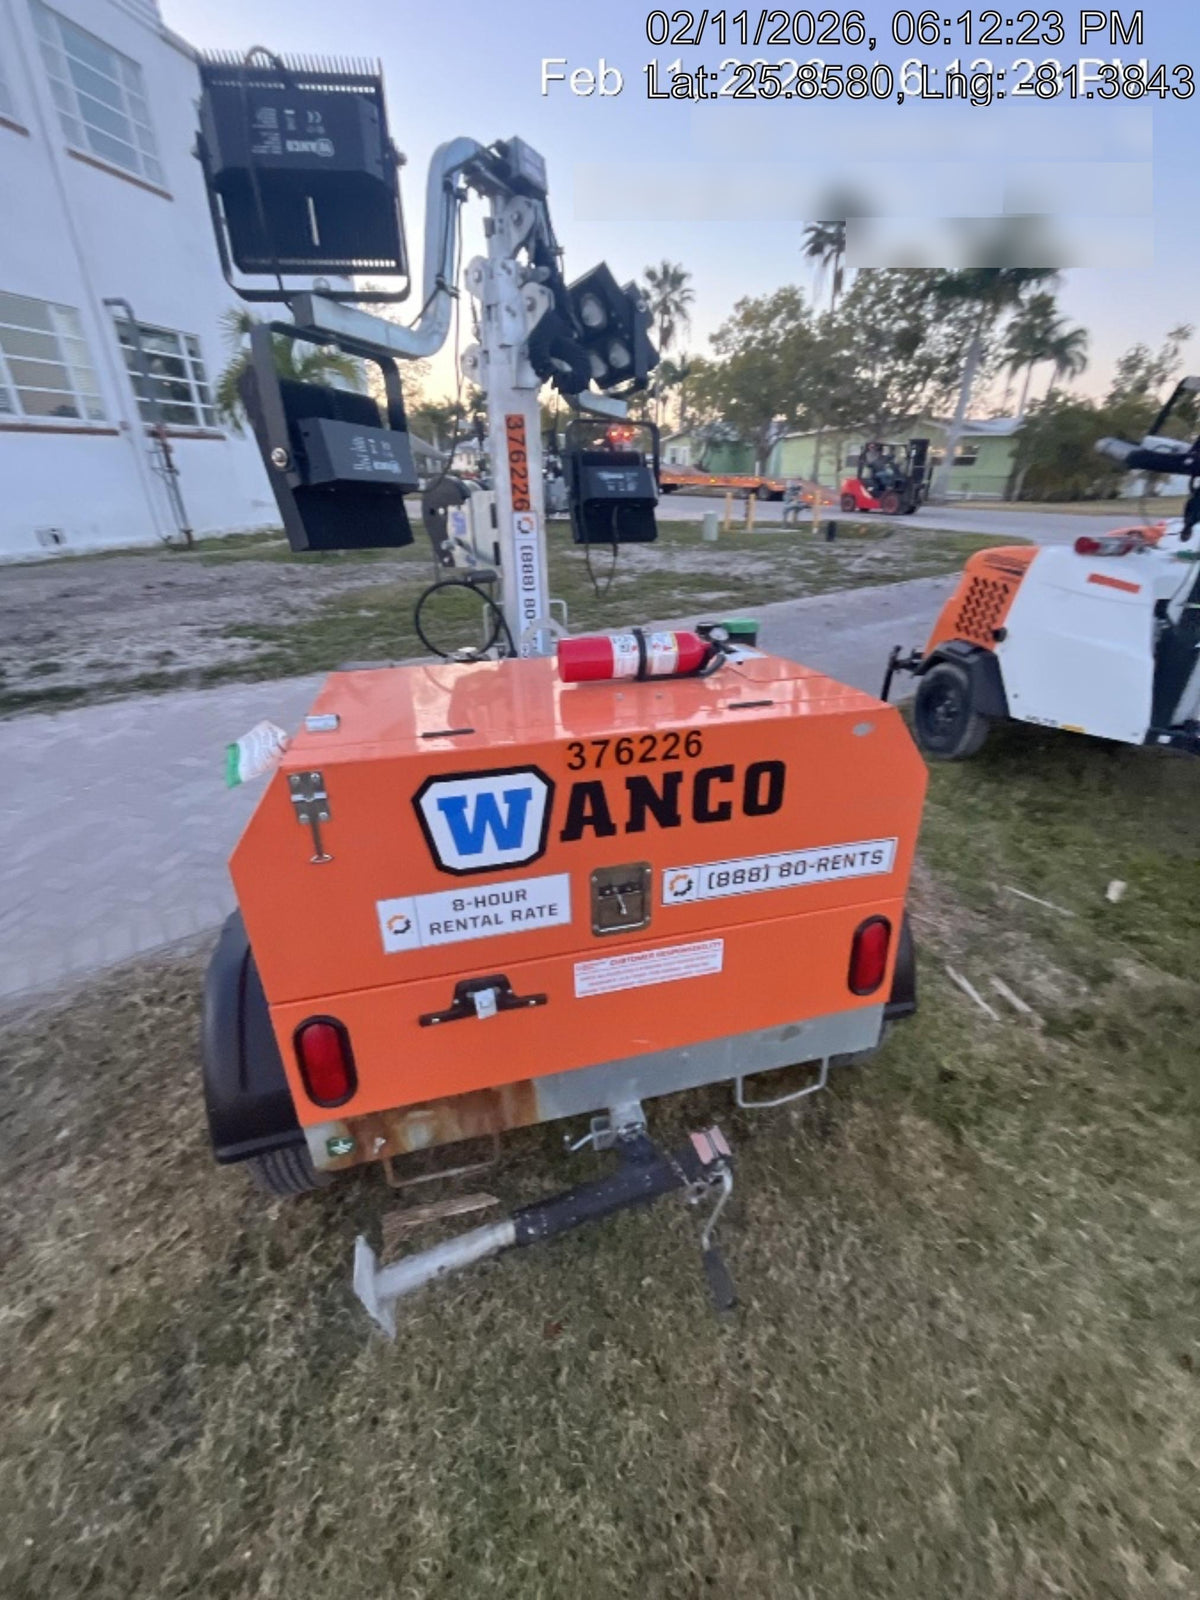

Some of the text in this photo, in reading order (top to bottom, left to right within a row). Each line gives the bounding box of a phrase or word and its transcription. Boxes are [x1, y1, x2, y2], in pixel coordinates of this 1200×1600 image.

[506, 415, 531, 512] 376226
[520, 545, 536, 592] (888)
[567, 730, 703, 770] 376226
[436, 760, 787, 857] WANCO
[707, 849, 884, 890] (888) 80-RENTS
[429, 903, 559, 936] RENTAL RATE
[451, 888, 528, 912] 8-HOUR
